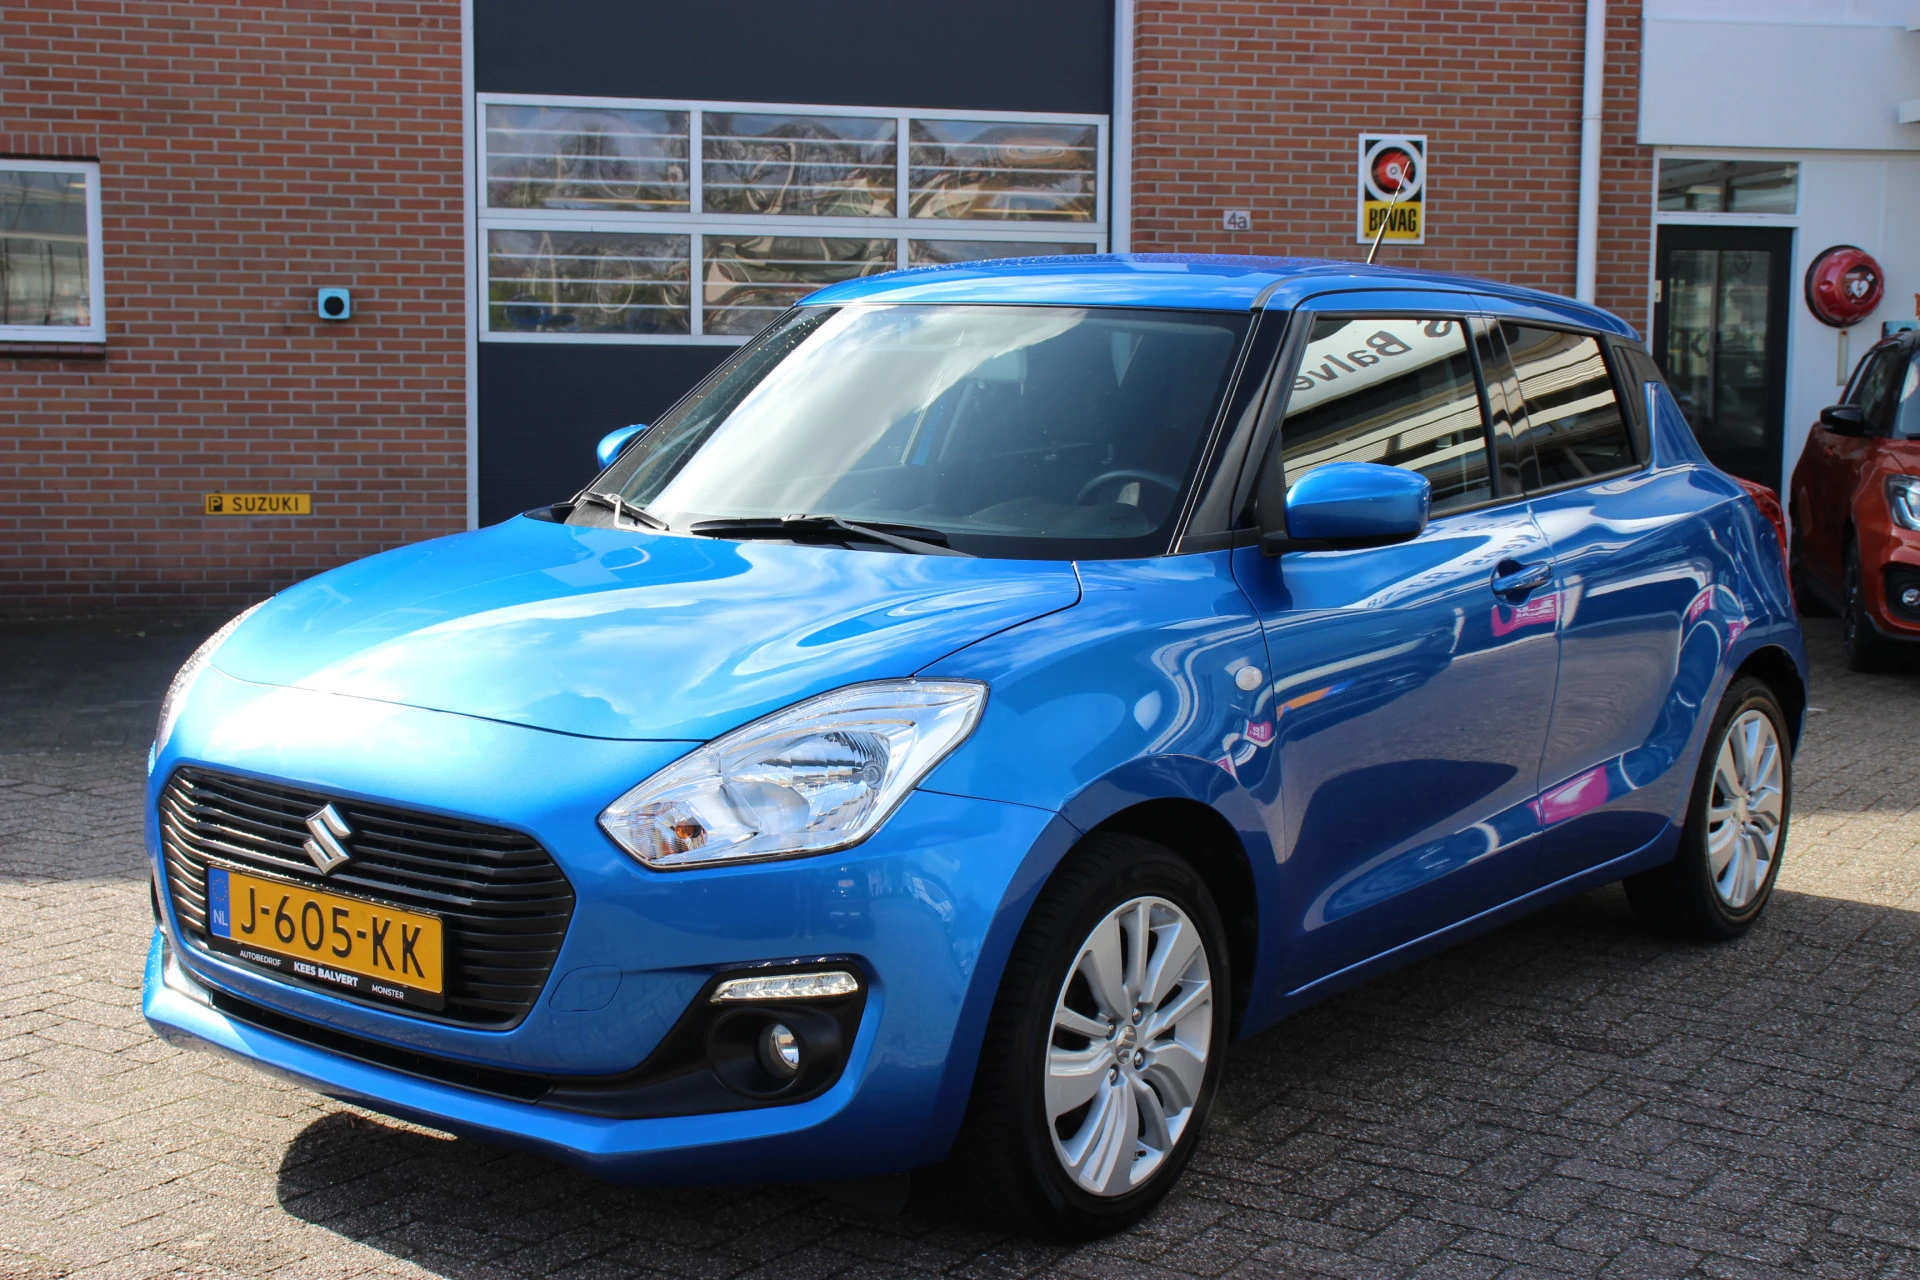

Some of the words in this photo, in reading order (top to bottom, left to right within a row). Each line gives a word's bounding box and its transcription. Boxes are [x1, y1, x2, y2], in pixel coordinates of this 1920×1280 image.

[1227, 211, 1248, 229] 4a
[1369, 207, 1417, 233] BOVAG
[232, 496, 299, 512] SUZUKI
[213, 909, 229, 927] NL
[241, 886, 425, 979] J-605-KK
[293, 961, 317, 977] KEES
[318, 968, 359, 987] BALVERT
[372, 984, 404, 1000] MONSTER
